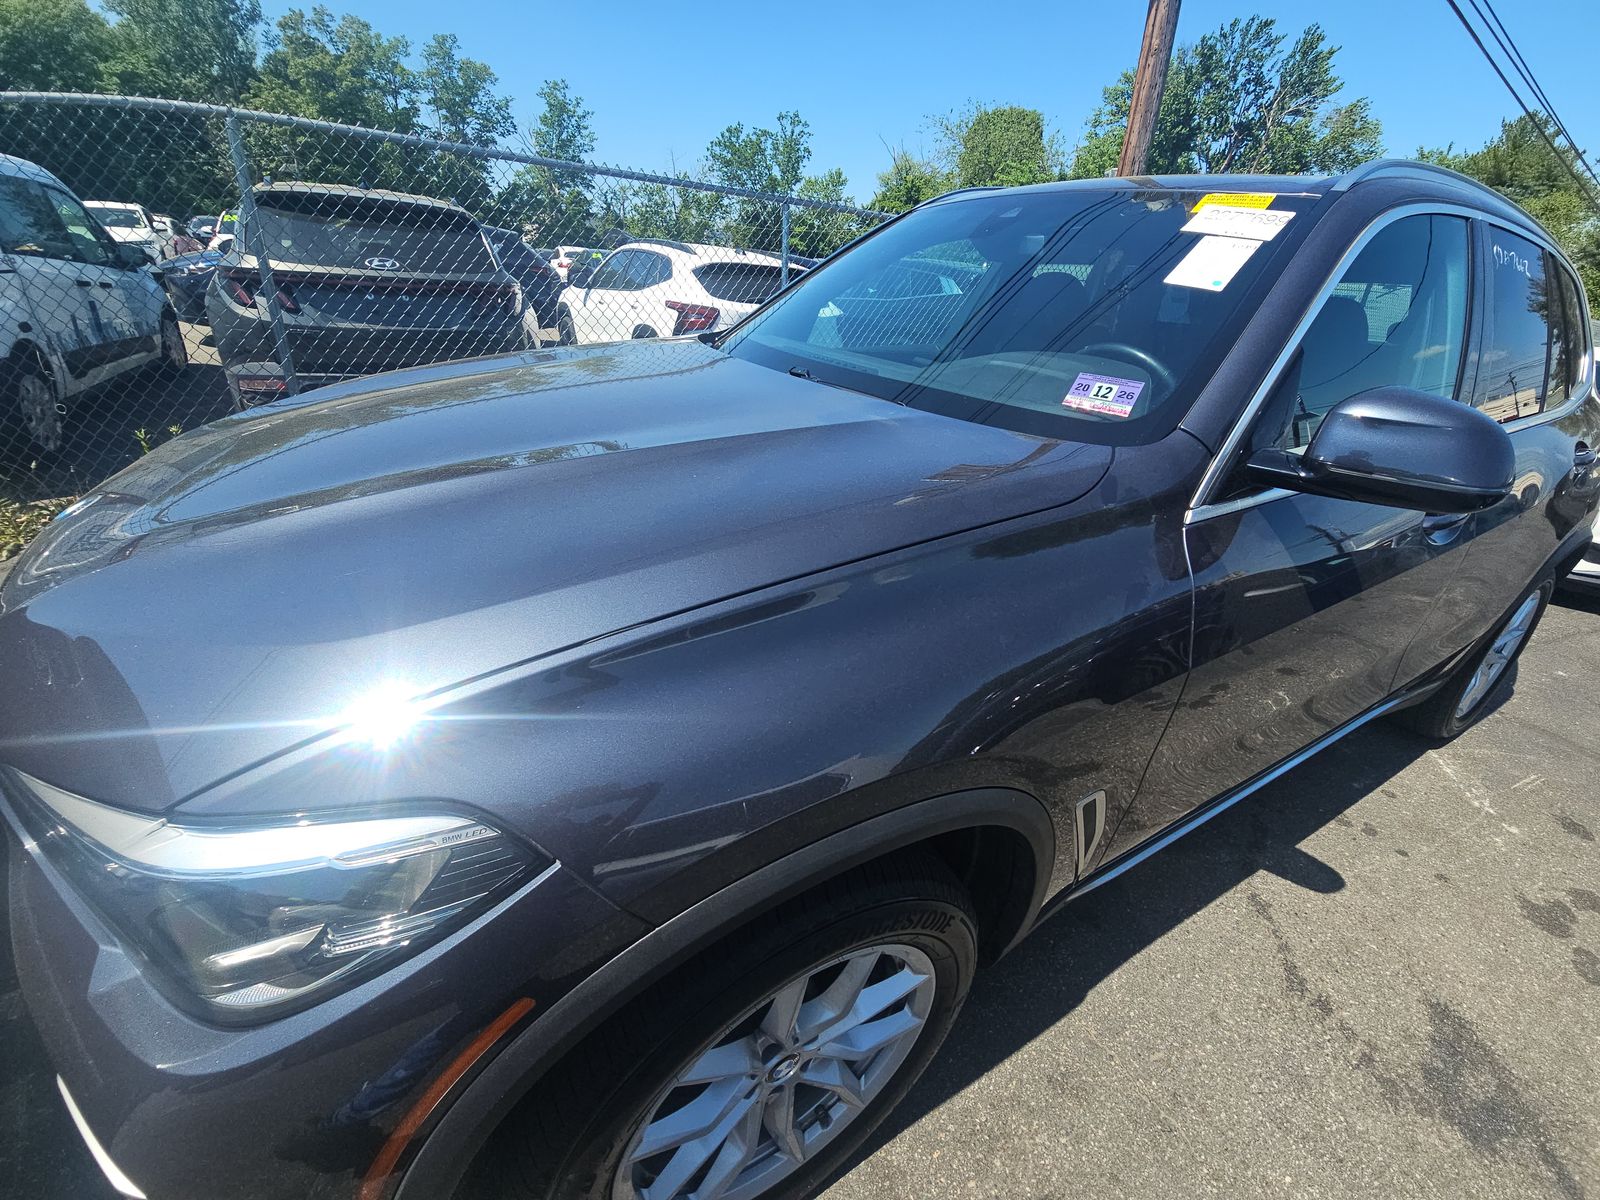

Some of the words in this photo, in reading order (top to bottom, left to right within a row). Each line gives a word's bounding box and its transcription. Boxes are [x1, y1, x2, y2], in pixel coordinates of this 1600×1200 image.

[1074, 382, 1091, 392] 20
[1092, 385, 1114, 399] 12
[1117, 390, 1136, 400] 26
[441, 833, 463, 844] BMW
[465, 827, 488, 838] LED
